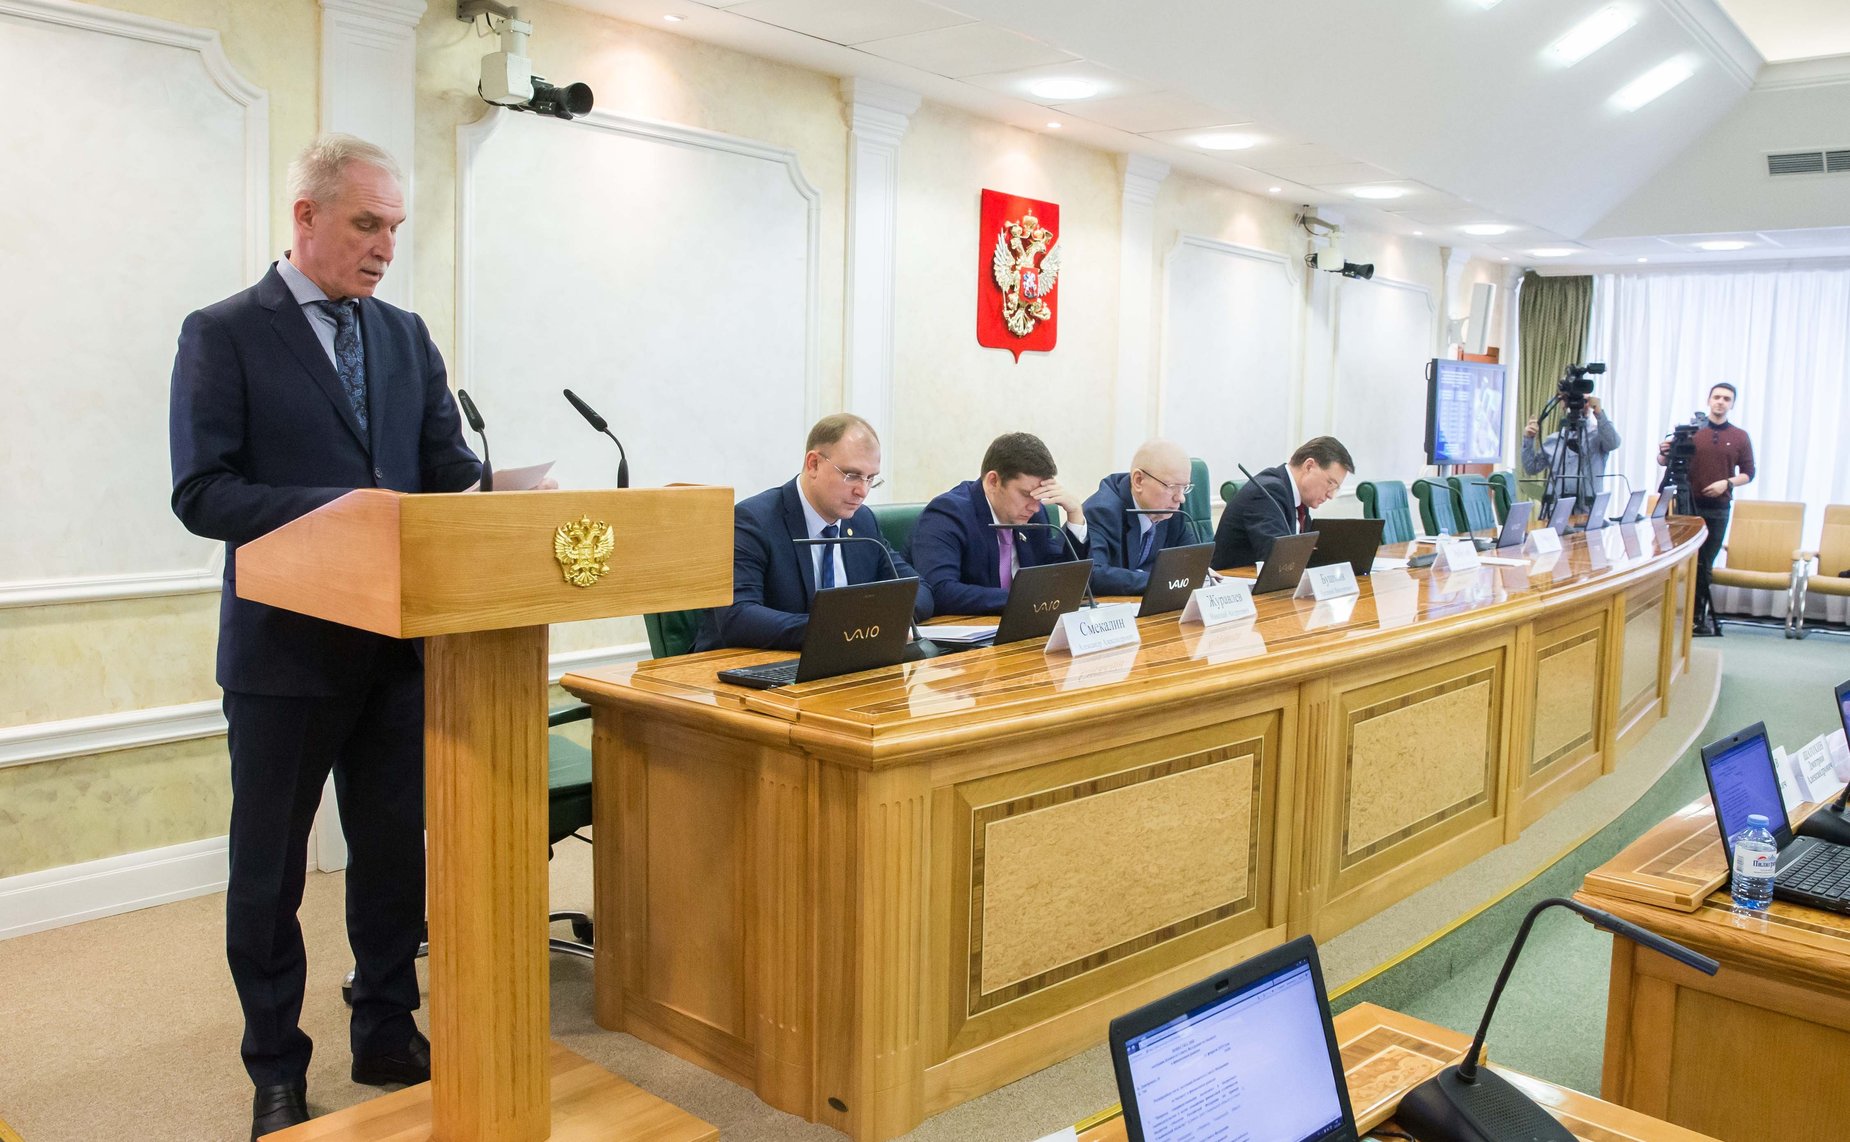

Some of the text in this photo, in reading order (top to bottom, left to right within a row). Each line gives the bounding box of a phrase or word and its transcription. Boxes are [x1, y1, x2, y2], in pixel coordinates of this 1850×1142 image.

[1168, 577, 1190, 590] VAIO
[1033, 599, 1060, 613] VAIO
[843, 625, 880, 642] VAIO
[1079, 618, 1126, 637] Смекалин
